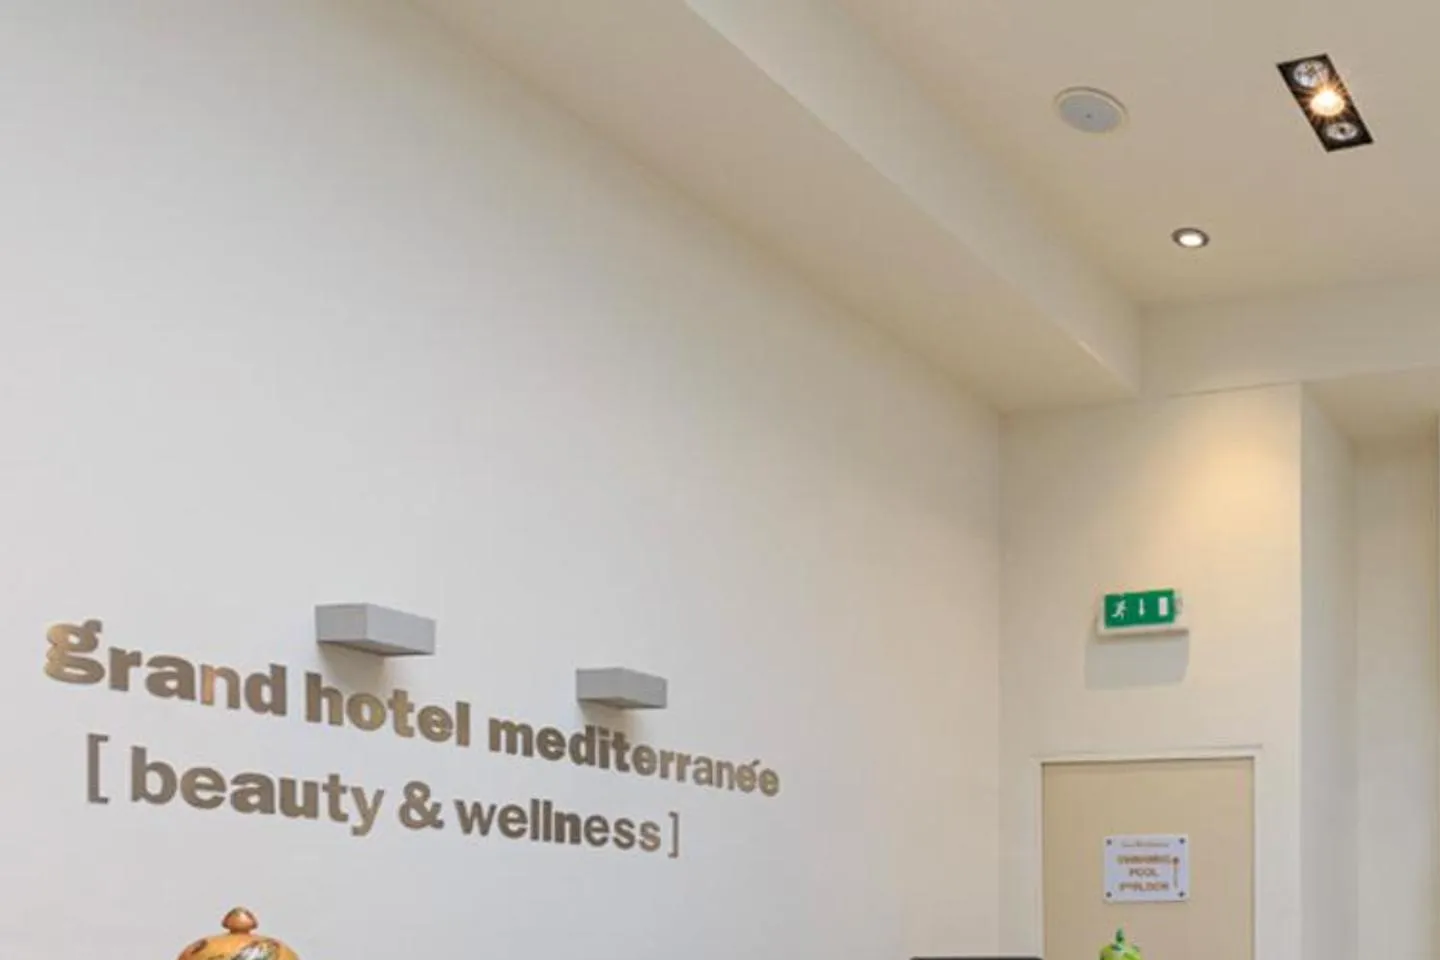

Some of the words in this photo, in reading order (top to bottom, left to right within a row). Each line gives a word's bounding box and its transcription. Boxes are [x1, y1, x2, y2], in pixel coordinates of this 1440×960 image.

[43, 618, 288, 717] grand
[304, 672, 471, 747] hotel
[487, 717, 780, 797] mediterranée
[398, 780, 444, 830] &
